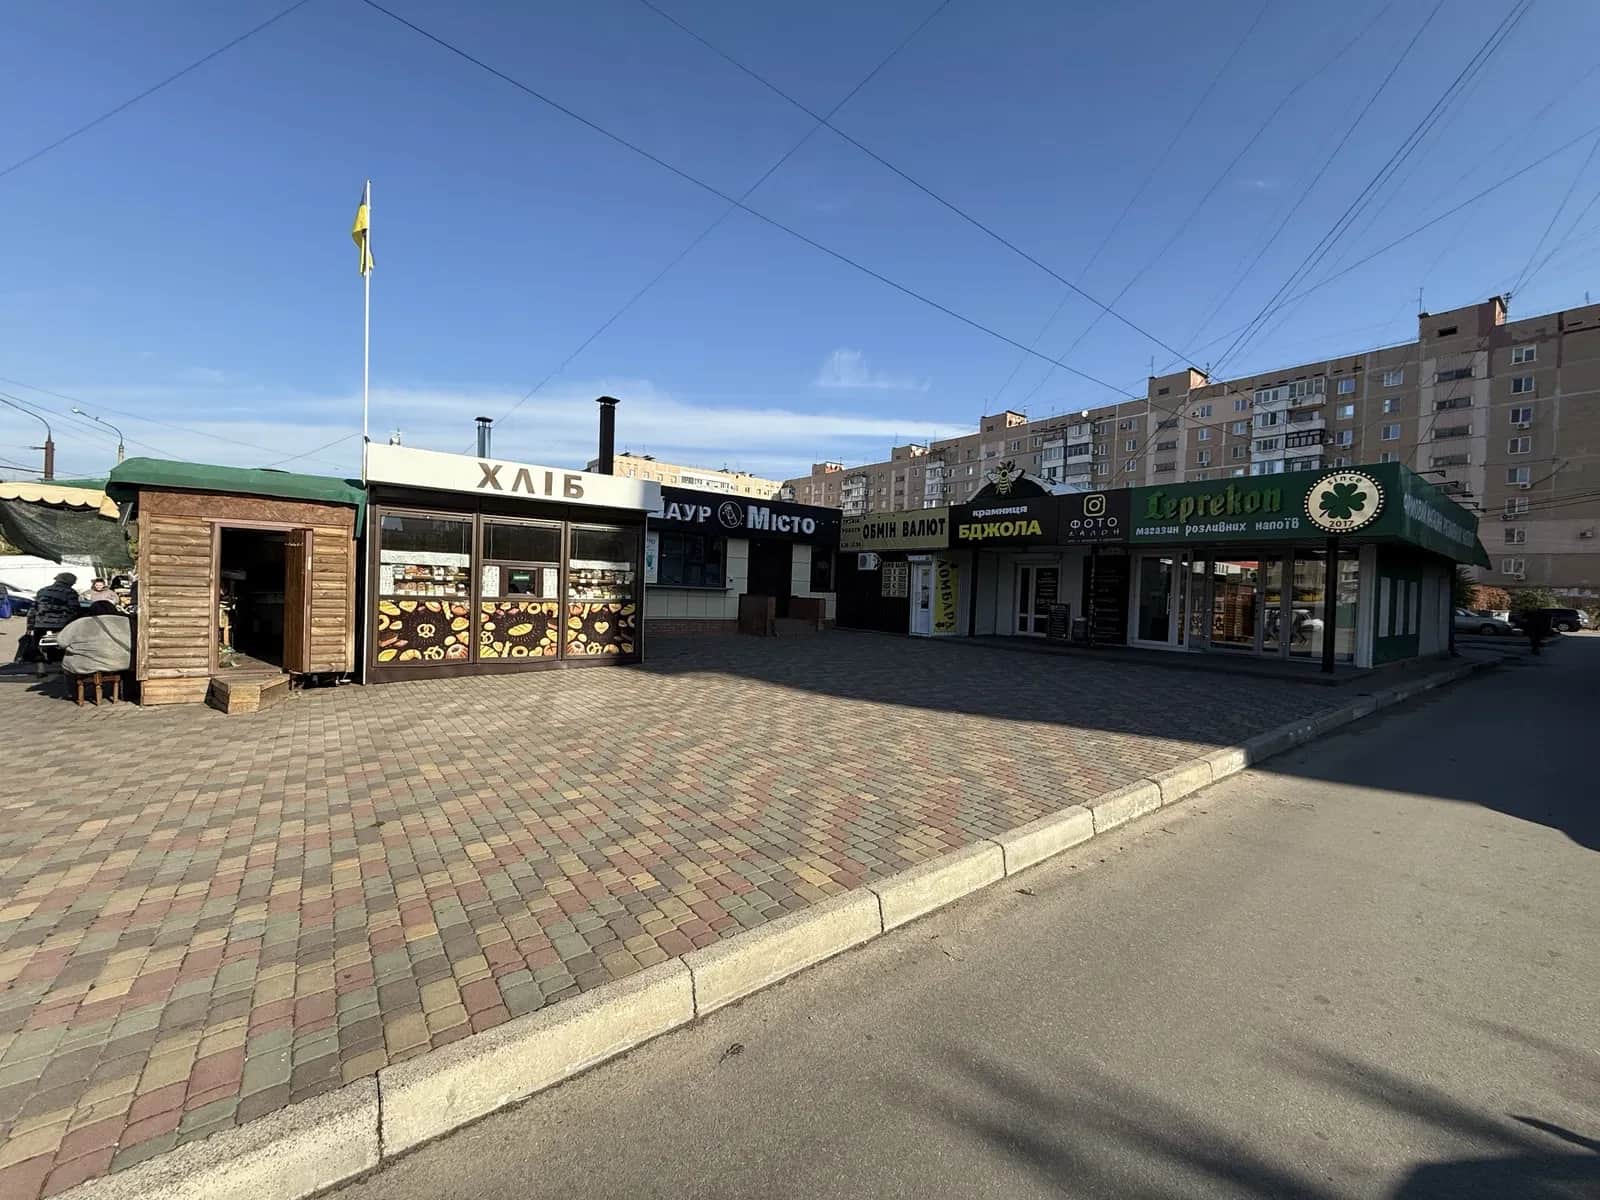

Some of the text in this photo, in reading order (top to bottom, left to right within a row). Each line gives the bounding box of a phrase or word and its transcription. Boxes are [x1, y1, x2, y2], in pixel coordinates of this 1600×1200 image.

[477, 462, 585, 499] ХЛІБ
[1327, 475, 1363, 485] since
[972, 505, 1028, 518] крамниця
[863, 518, 946, 539] ОБМІН ВАЛЮТ
[957, 519, 1042, 541] БДЖОЛА
[1070, 516, 1118, 529] ФОТО
[1136, 517, 1300, 537] магазин розливних напоїв
[1328, 519, 1354, 528] 2017
